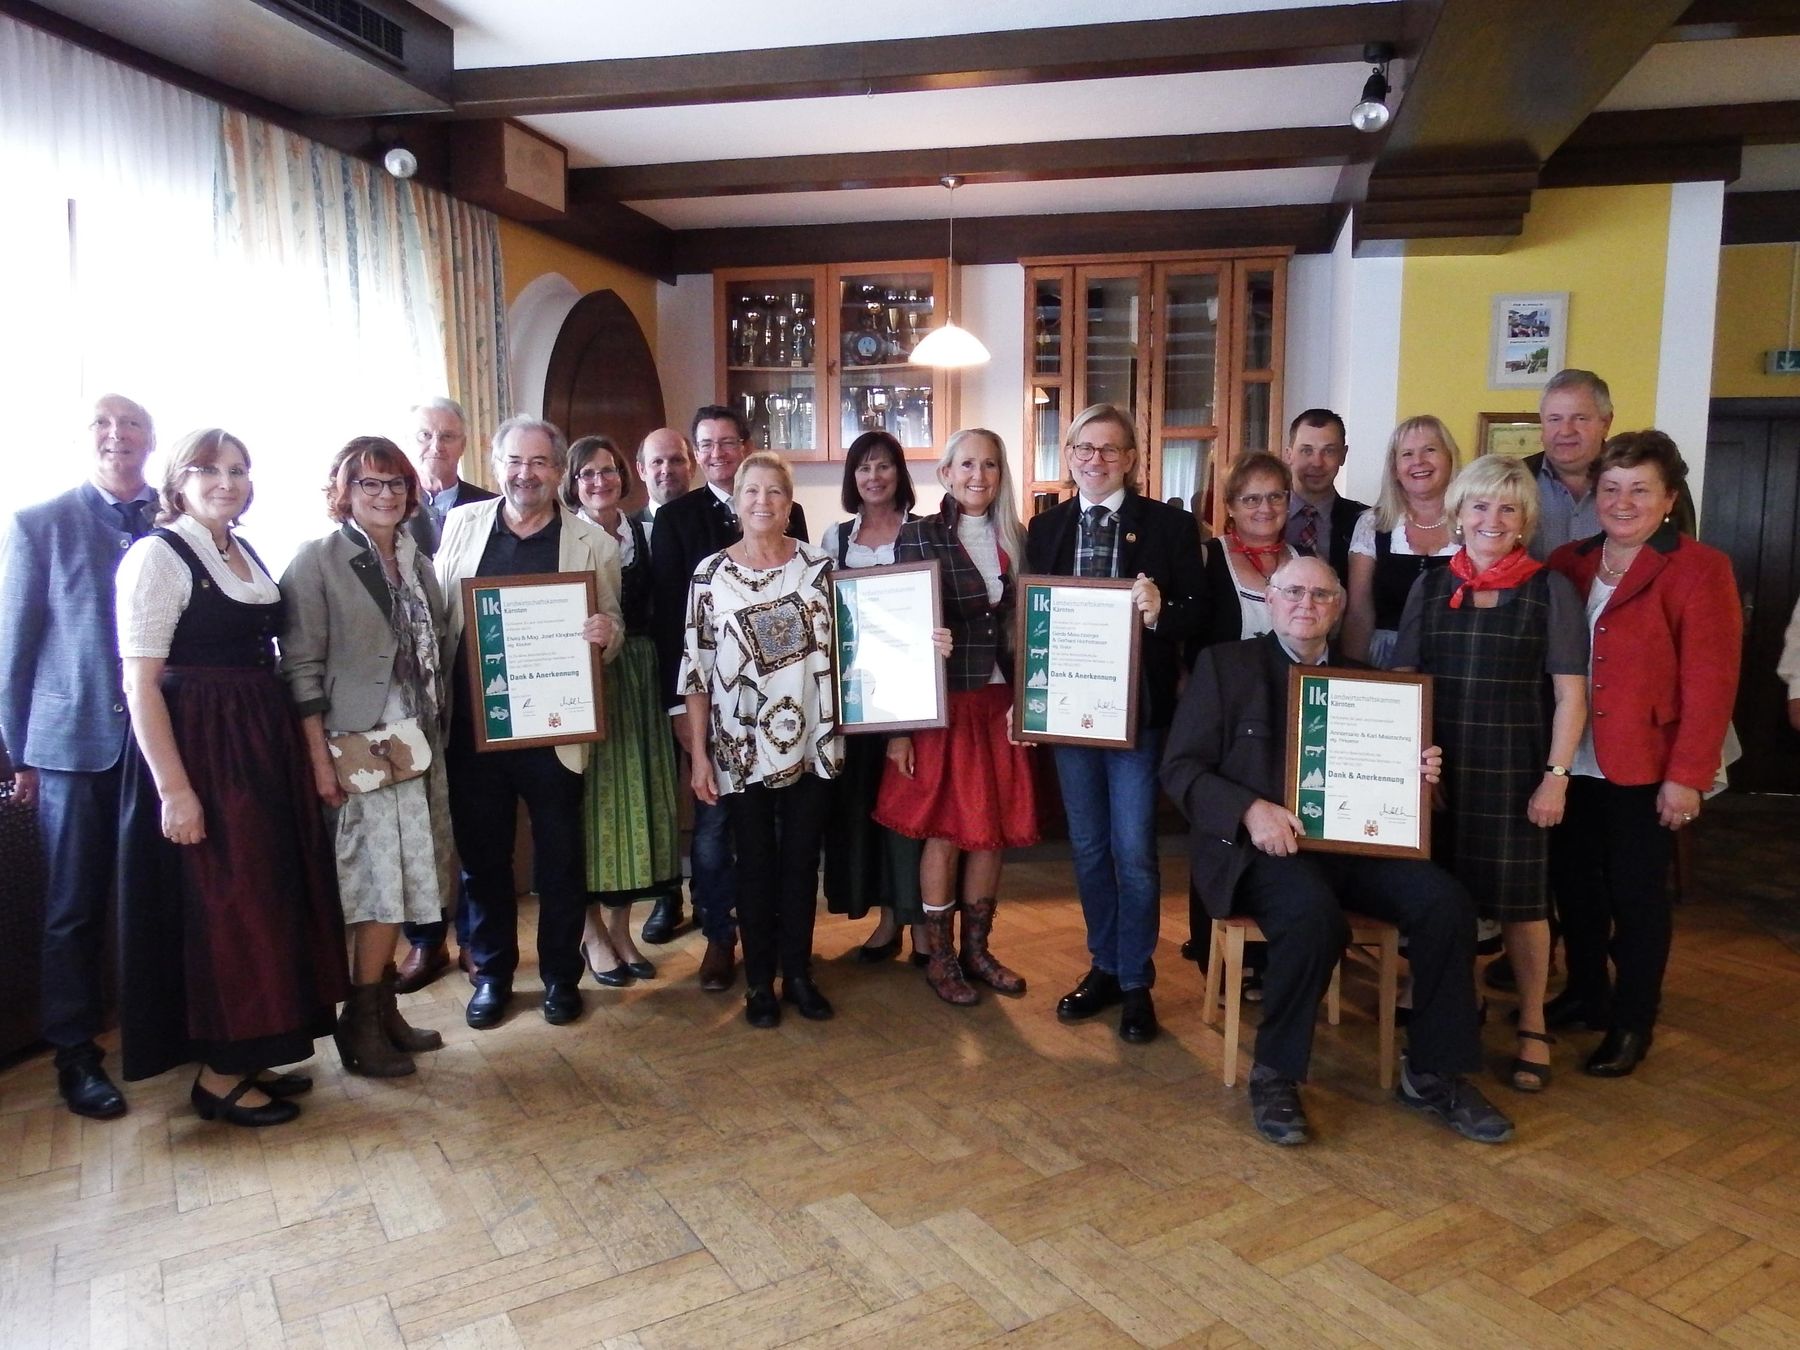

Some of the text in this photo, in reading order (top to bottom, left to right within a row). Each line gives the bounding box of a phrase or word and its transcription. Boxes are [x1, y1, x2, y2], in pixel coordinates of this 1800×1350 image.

[482, 597, 501, 616] lk
[1033, 594, 1050, 612] lk
[536, 670, 579, 679] Anerkennung
[1075, 672, 1117, 681] Anerkennung
[1309, 686, 1328, 706] lk
[1328, 770, 1346, 779] Dank
[1356, 773, 1405, 784] Anerkennung
